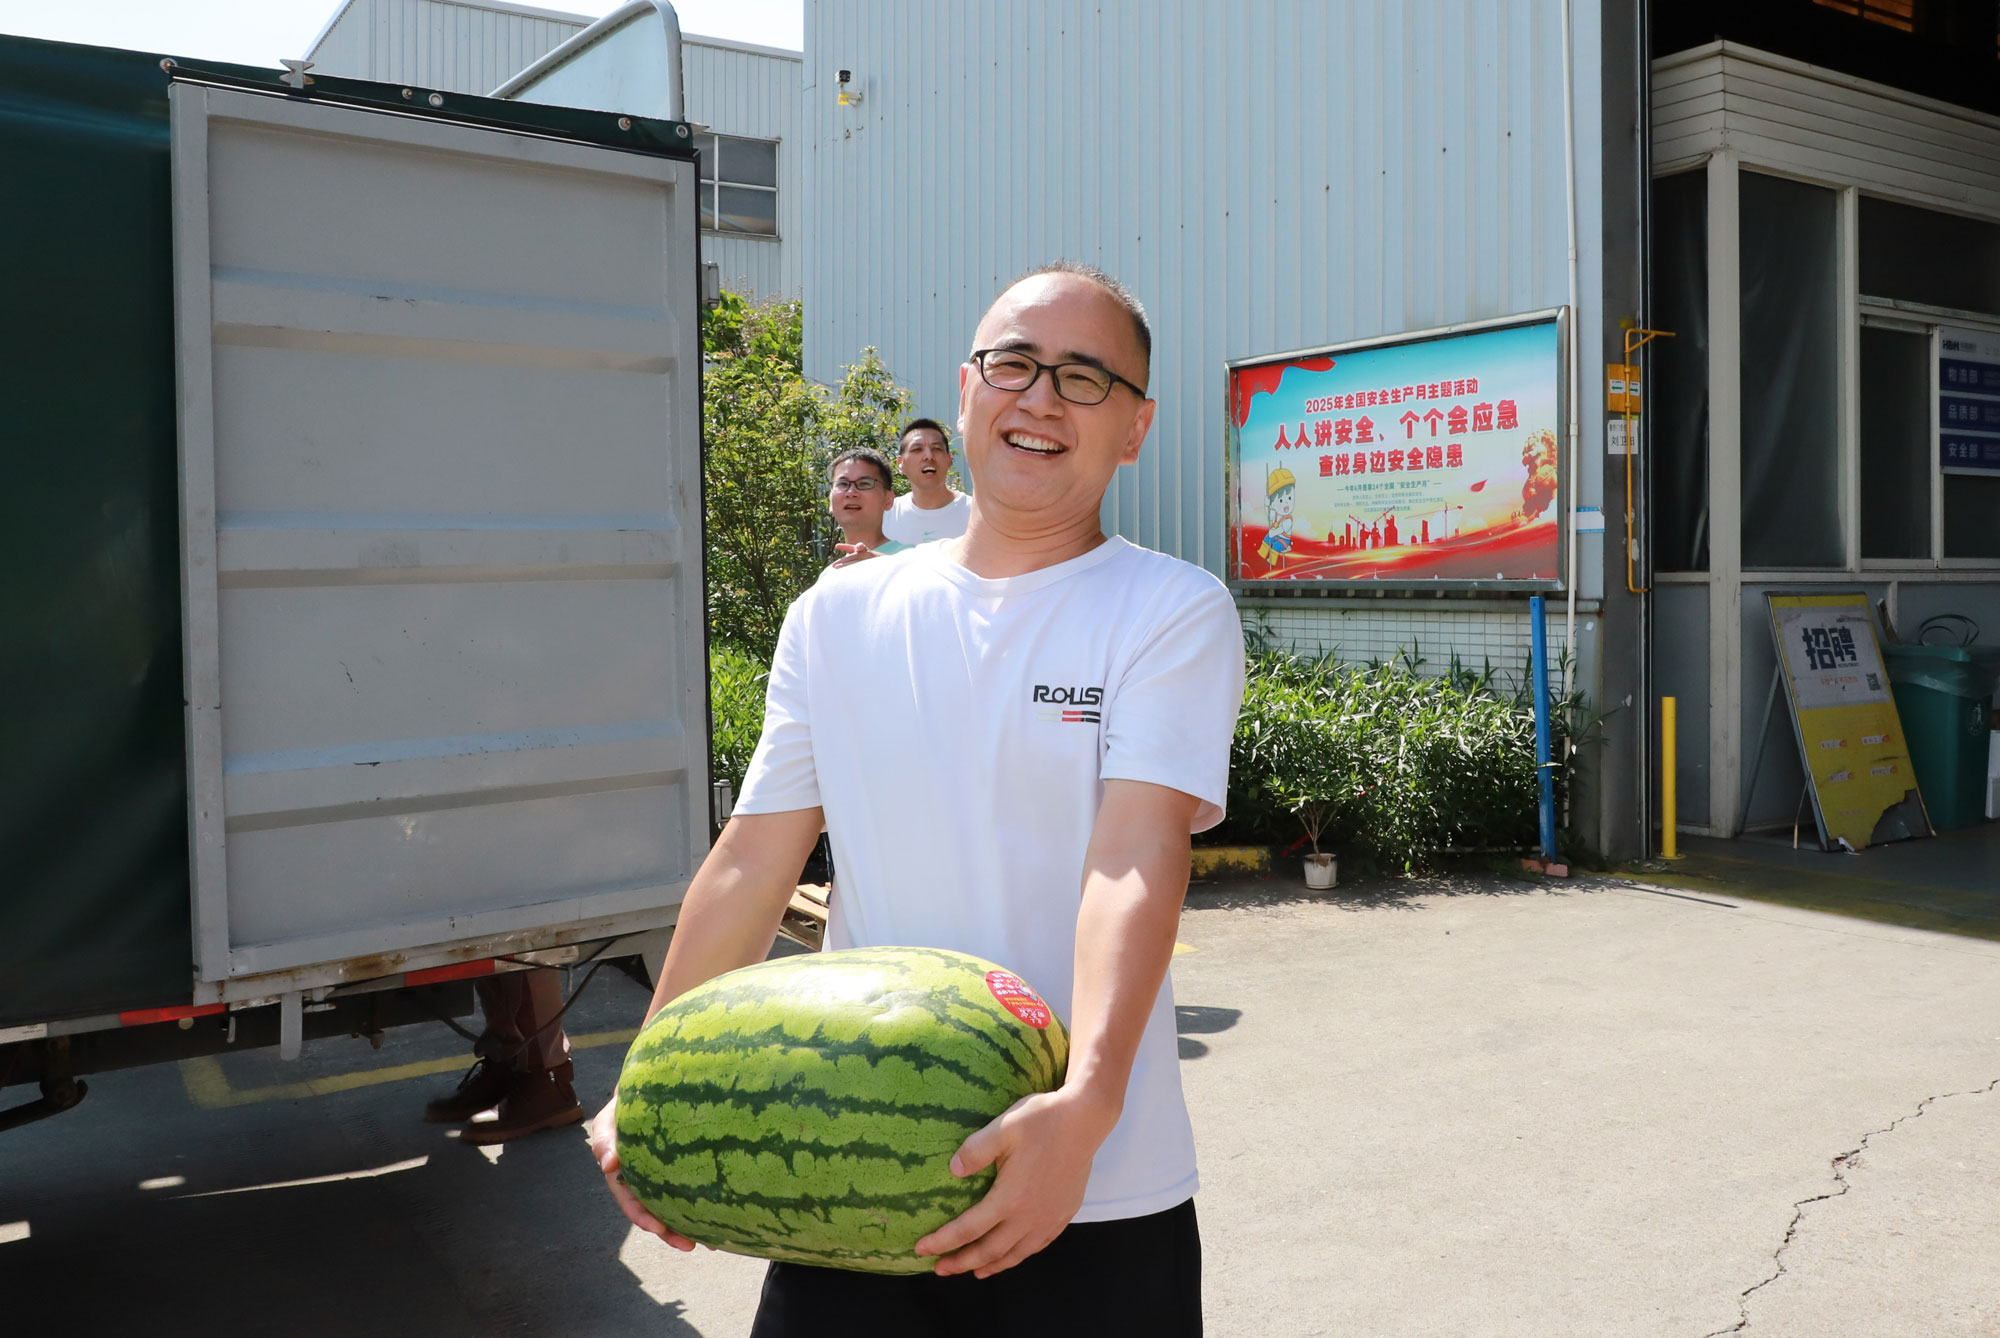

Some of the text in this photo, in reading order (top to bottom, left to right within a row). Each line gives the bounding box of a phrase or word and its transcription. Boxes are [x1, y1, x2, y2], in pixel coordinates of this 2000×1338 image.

[1305, 378, 1478, 413] 2025年全国安全生产月主题活动
[1274, 400, 1519, 451] 人人讲安全、个个会应急
[1319, 444, 1463, 477] 查找身边安全隐患
[1948, 443, 1978, 459] 安全部
[1802, 625, 1857, 670] 招聘
